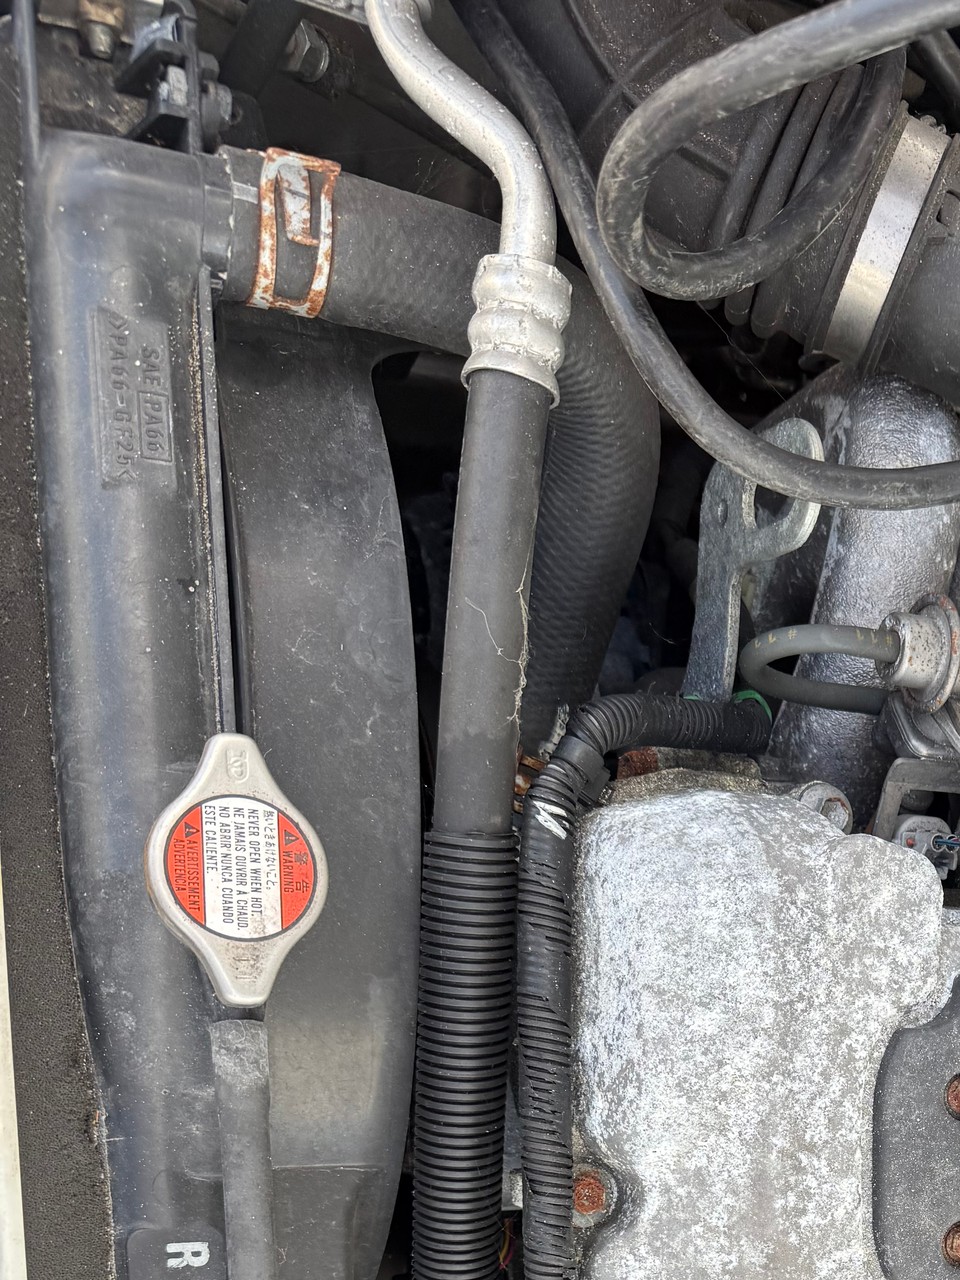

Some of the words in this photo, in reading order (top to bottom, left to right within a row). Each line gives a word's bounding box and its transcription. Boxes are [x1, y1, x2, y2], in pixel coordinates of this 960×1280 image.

[141, 347, 161, 386] SAE
[144, 400, 165, 452] PA66
[205, 805, 216, 826] ESTE
[219, 806, 230, 818] NO
[234, 808, 245, 819] NE
[248, 808, 259, 836] NEVER
[220, 823, 231, 848] ABRIR
[235, 821, 246, 852] JAMAIS
[263, 809, 277, 891] 熱いときあけないこと。
[174, 838, 186, 891] ADVERTENCIA
[206, 830, 217, 874] CALIENTE.
[221, 852, 232, 883] NUNCA
[249, 841, 260, 863] OPEN
[187, 839, 200, 911] AVERTISSEMENT
[236, 855, 247, 886] OUVRIR
[250, 868, 261, 893] WHEN
[282, 850, 294, 893] WARNING
[295, 851, 309, 893] 警告
[223, 888, 233, 924] CUANDO
[237, 899, 248, 931] CHAUD.
[251, 897, 262, 916] HOT.
[166, 1242, 210, 1269] R
